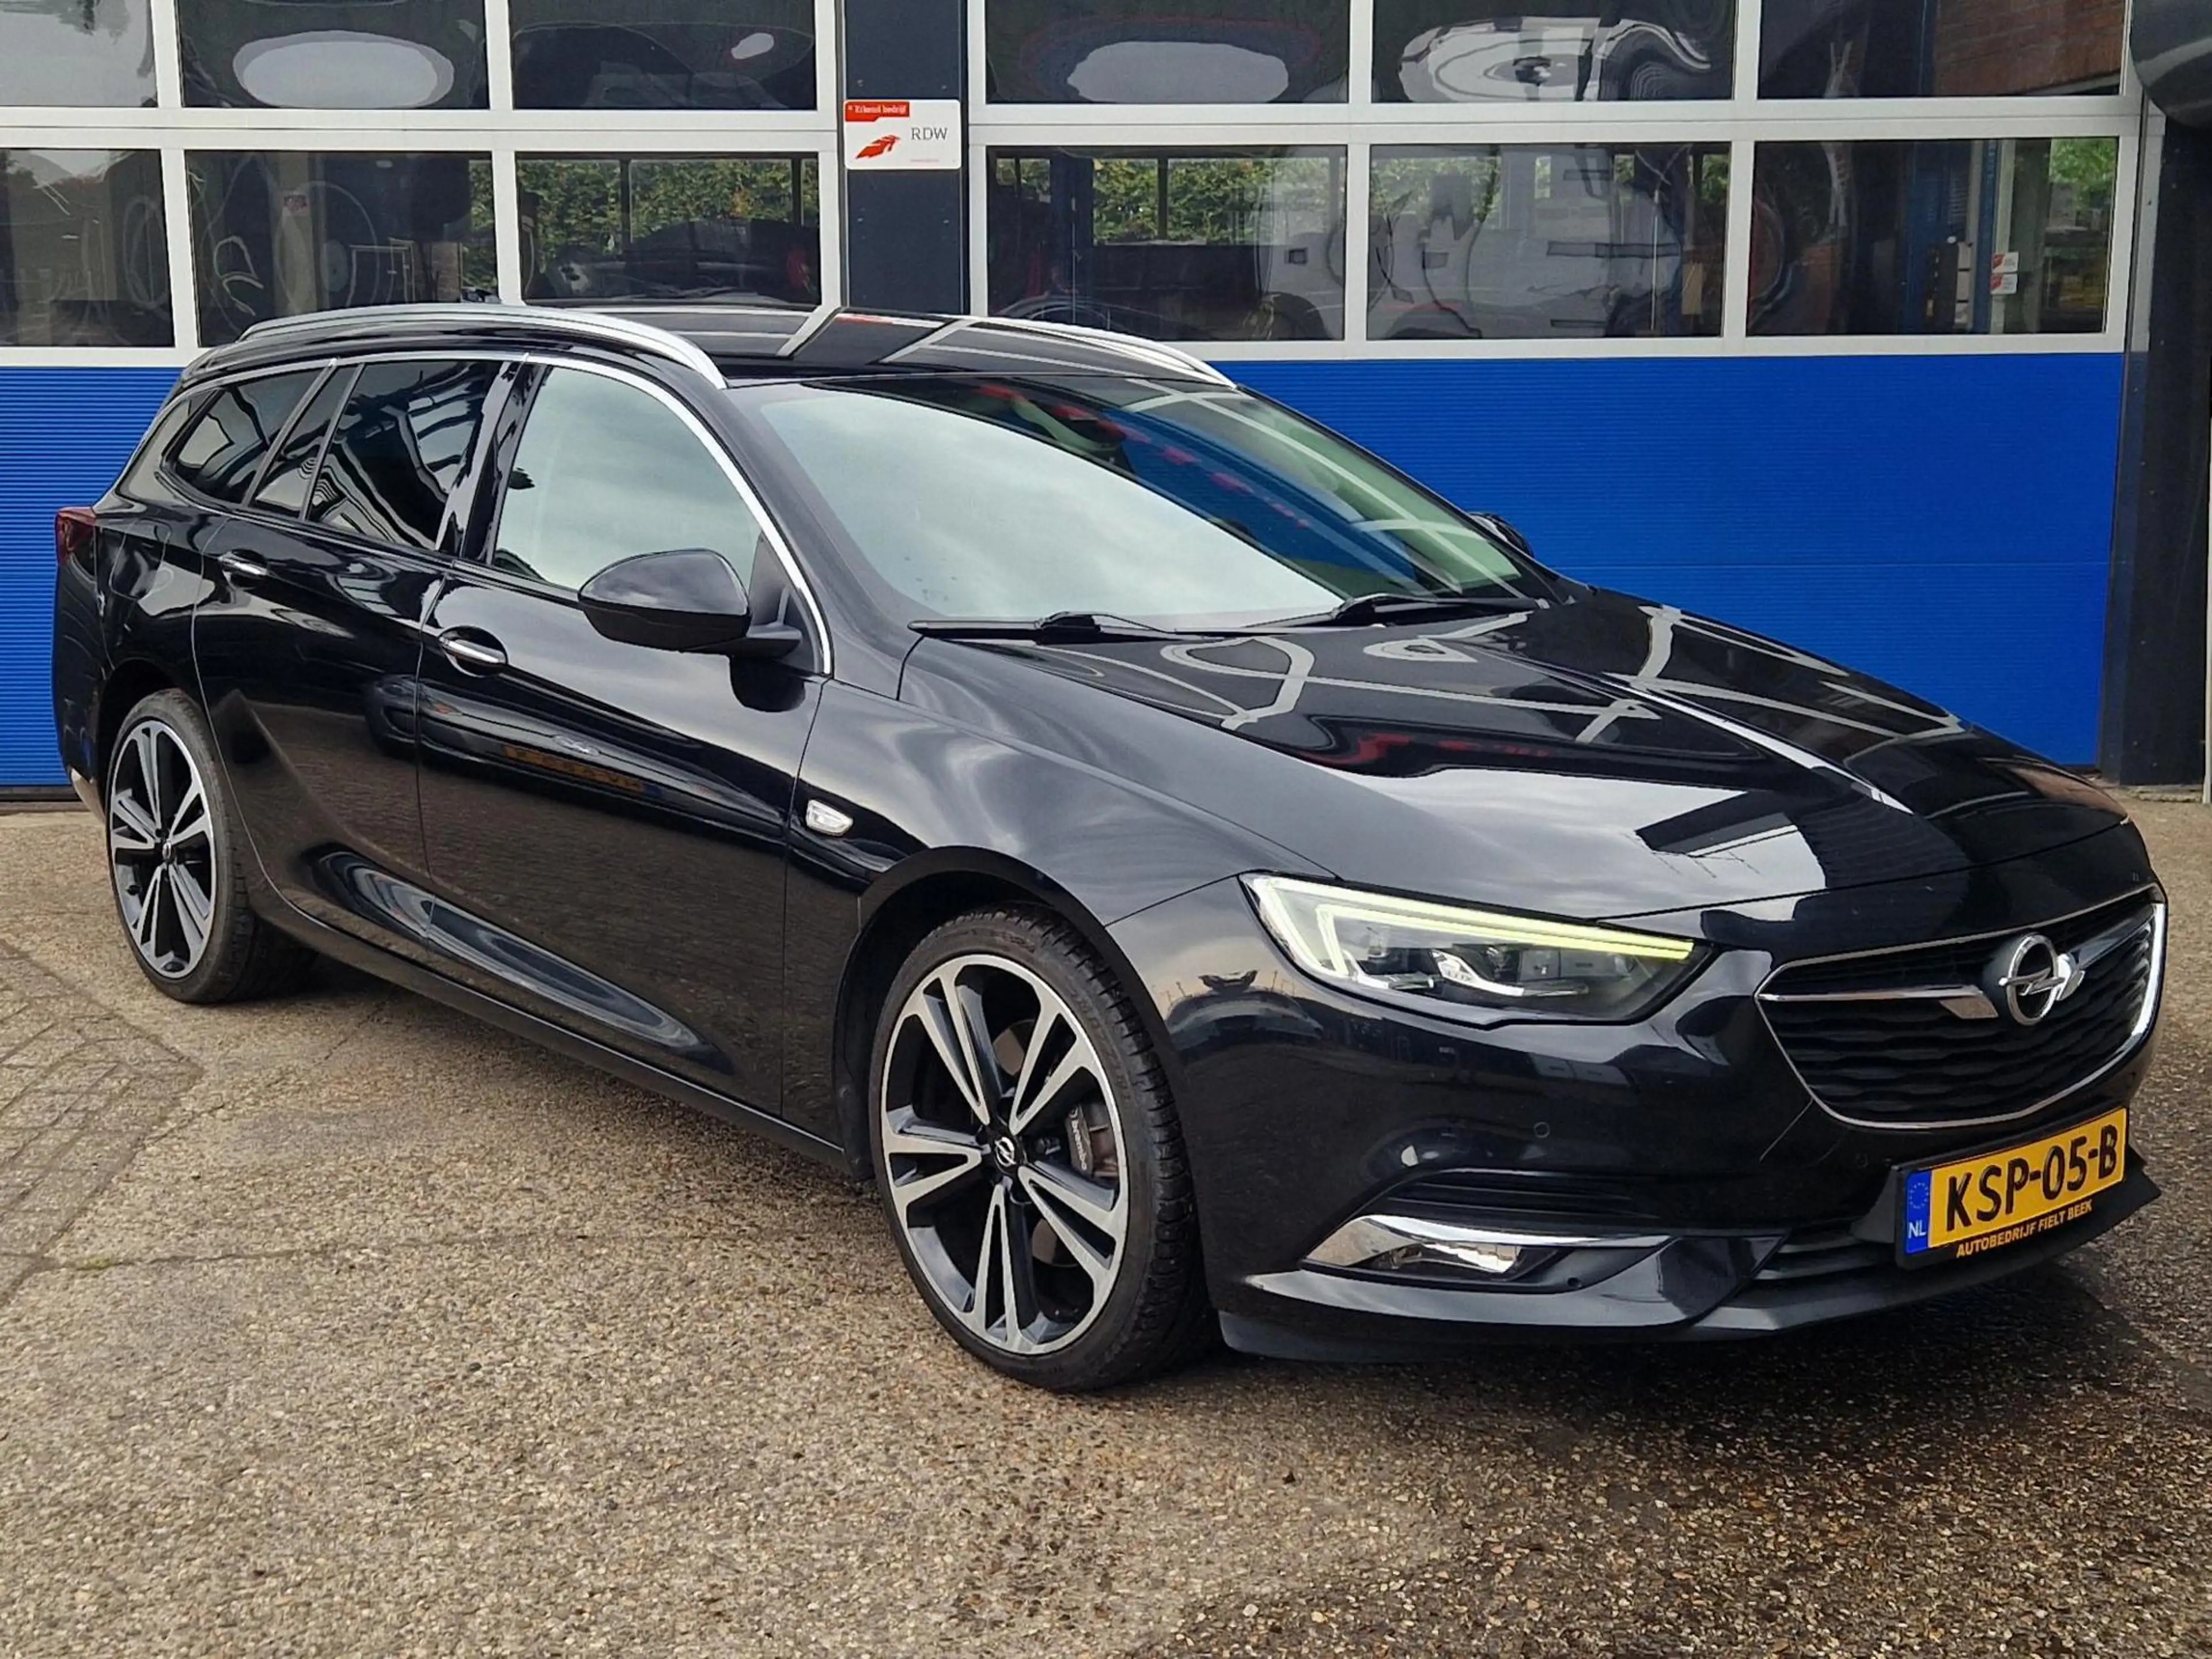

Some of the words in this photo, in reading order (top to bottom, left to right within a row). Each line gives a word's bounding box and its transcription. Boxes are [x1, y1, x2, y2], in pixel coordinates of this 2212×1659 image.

[911, 127, 948, 141] RDW
[1071, 1120, 1087, 1171] brembo
[1946, 1124, 2118, 1232] KSP-05-B
[1908, 1219, 1926, 1238] NL
[1956, 1221, 2036, 1258] AUTOBEDRIJF
[2038, 1210, 2066, 1232] FIELT
[2067, 1199, 2093, 1221] BEEK
